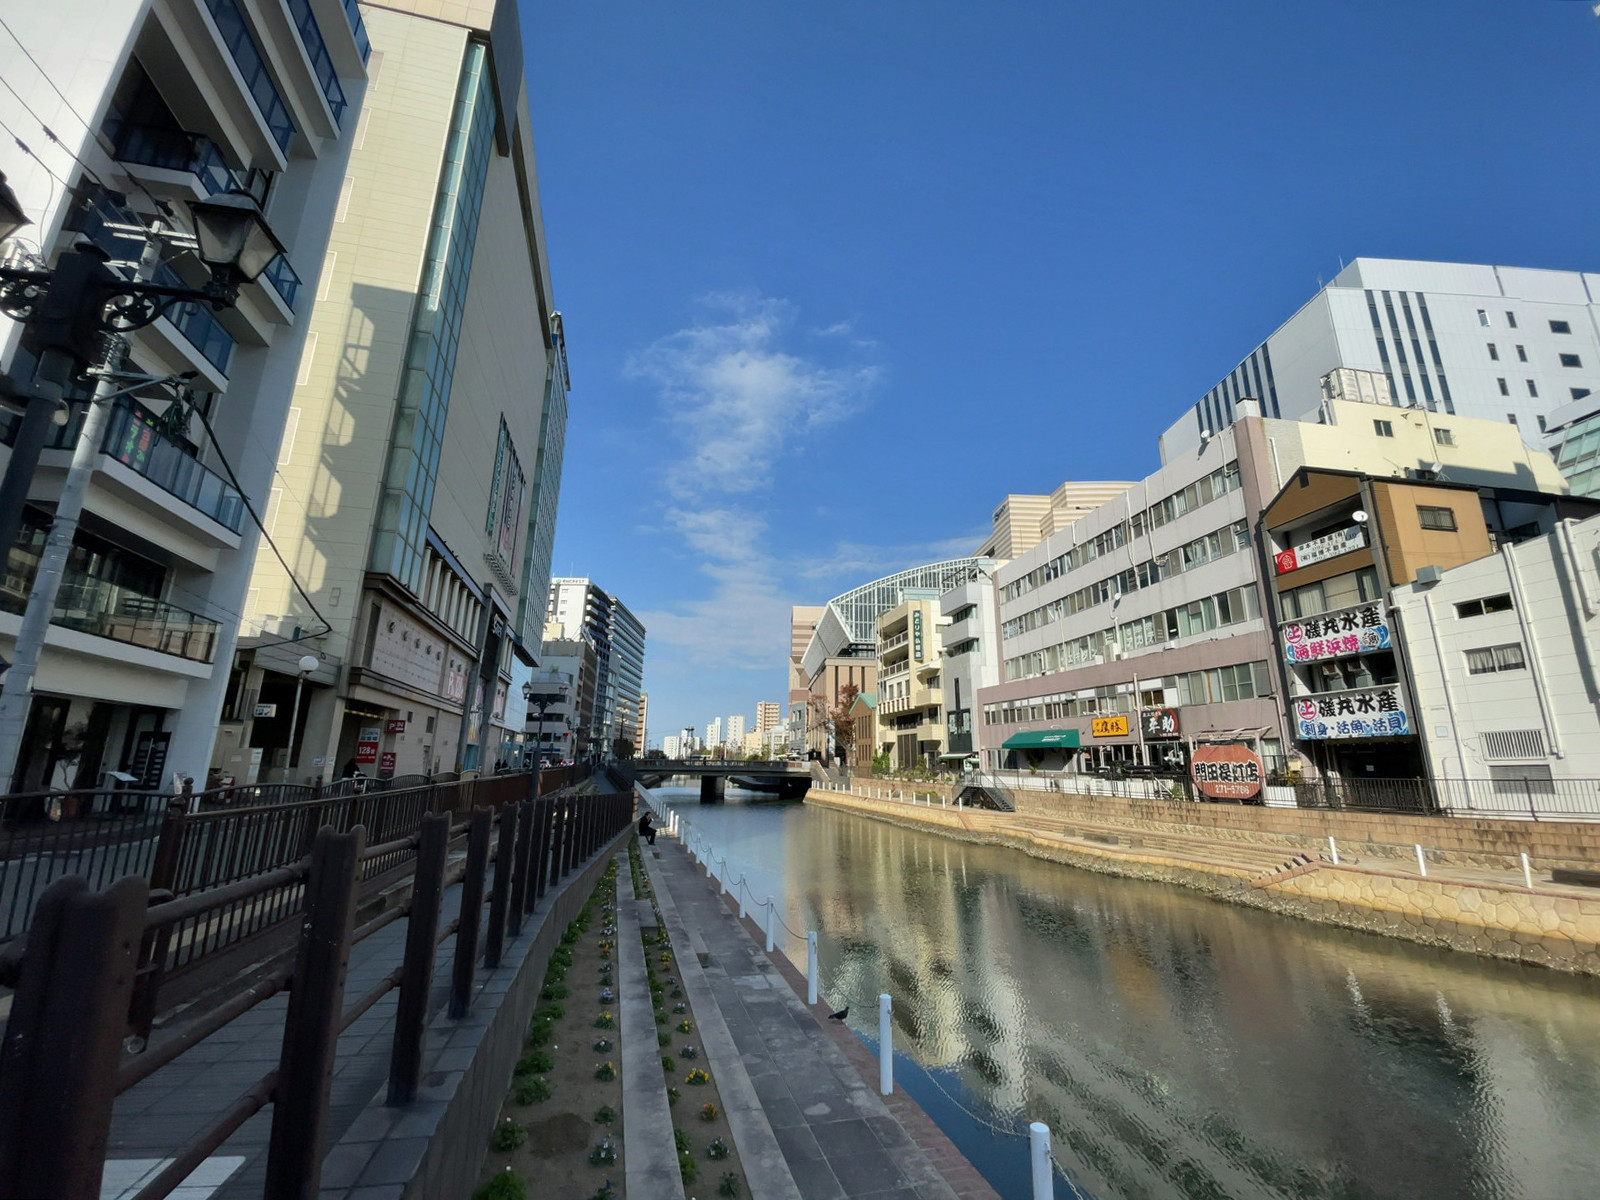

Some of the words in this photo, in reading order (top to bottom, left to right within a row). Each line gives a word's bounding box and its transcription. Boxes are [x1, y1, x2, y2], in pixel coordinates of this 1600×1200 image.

[1304, 606, 1382, 640] 磯丸水産
[1295, 634, 1361, 660] 海鮮浜焼
[1318, 689, 1400, 718] 磯丸水産
[1194, 760, 1260, 783] 門田提灯店
